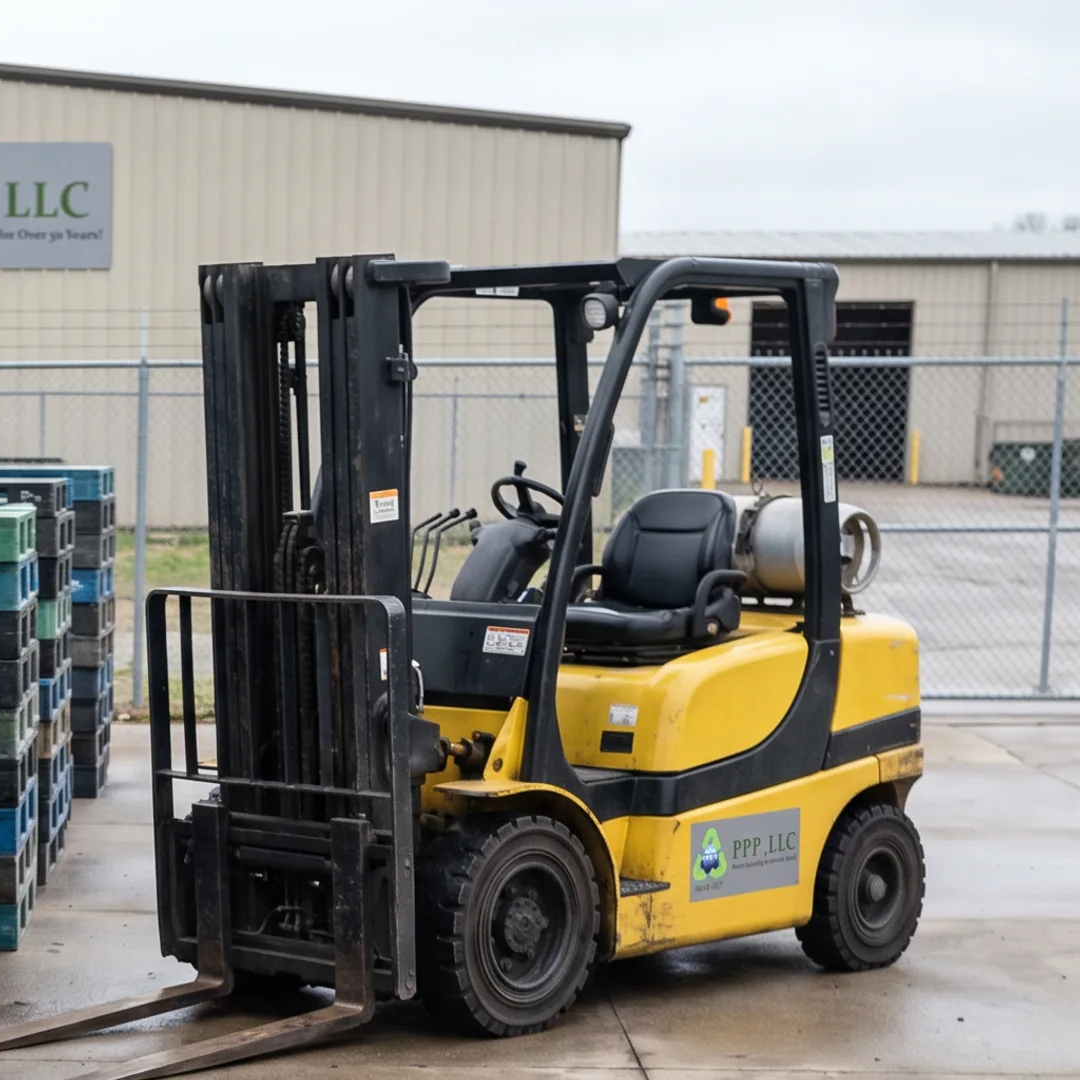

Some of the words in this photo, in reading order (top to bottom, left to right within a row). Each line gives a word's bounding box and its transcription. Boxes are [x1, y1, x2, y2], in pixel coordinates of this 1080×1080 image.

[4, 181, 91, 218] LLC
[17, 228, 47, 240] Over
[769, 831, 796, 853] LLC
